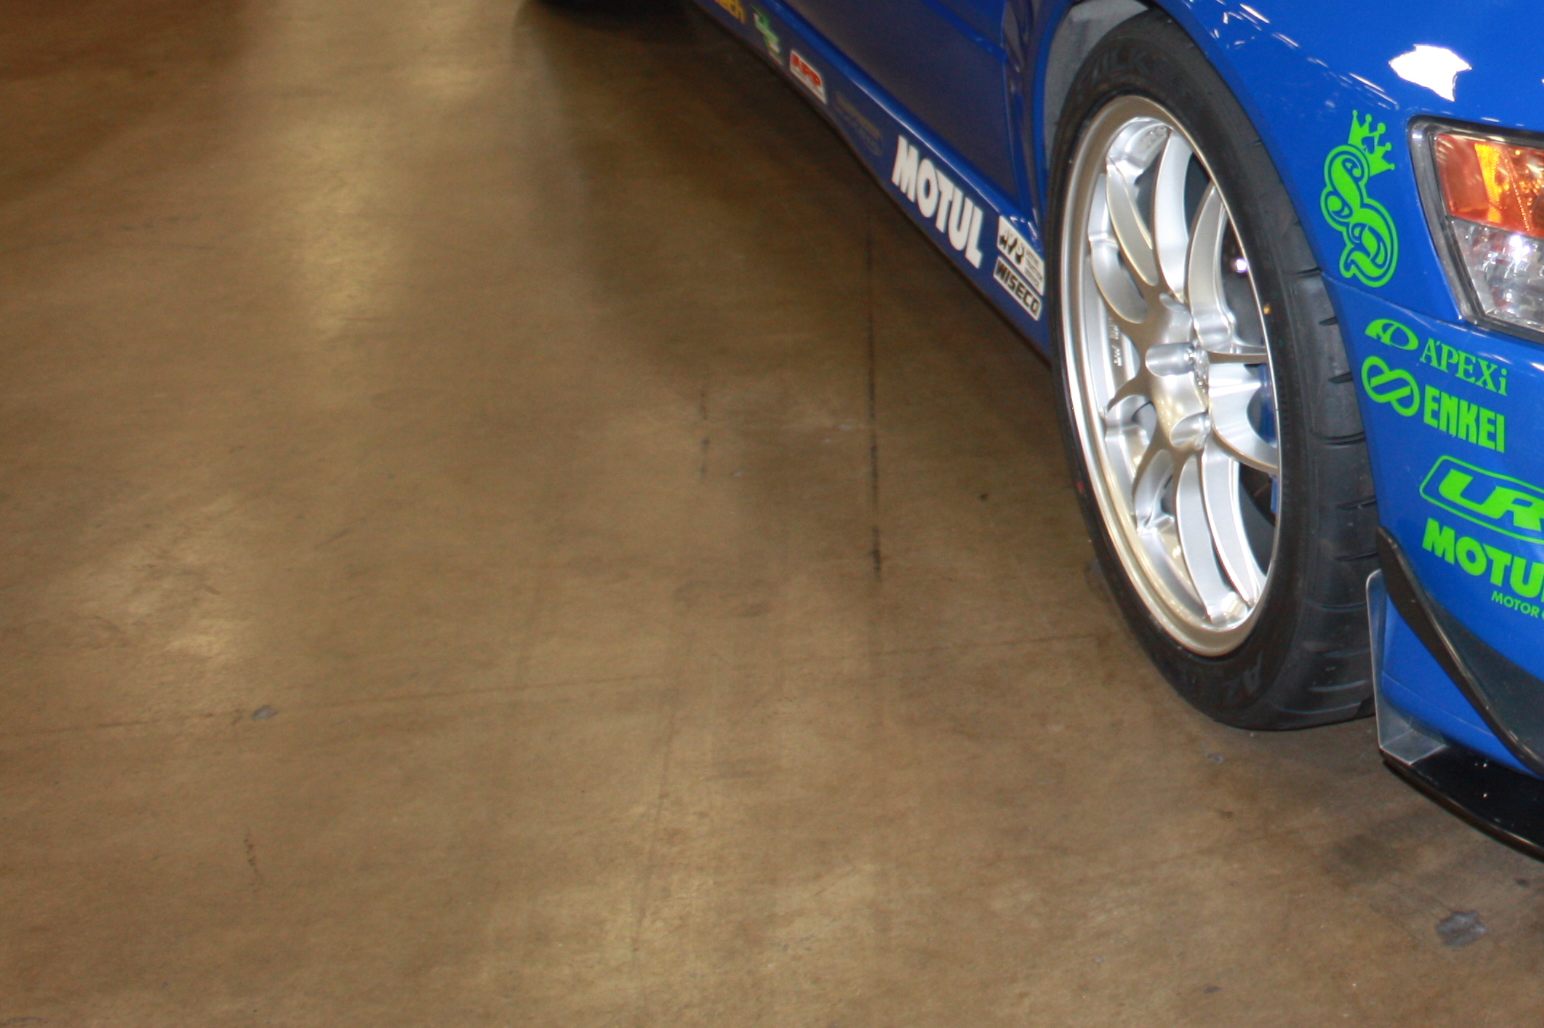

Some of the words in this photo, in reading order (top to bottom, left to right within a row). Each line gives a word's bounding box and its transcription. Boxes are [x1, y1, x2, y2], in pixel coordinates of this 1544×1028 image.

[891, 134, 984, 270] MOTUL
[996, 261, 1040, 313] WISECO
[1423, 384, 1505, 453] ENKEI
[1491, 589, 1540, 619] MOTOR
